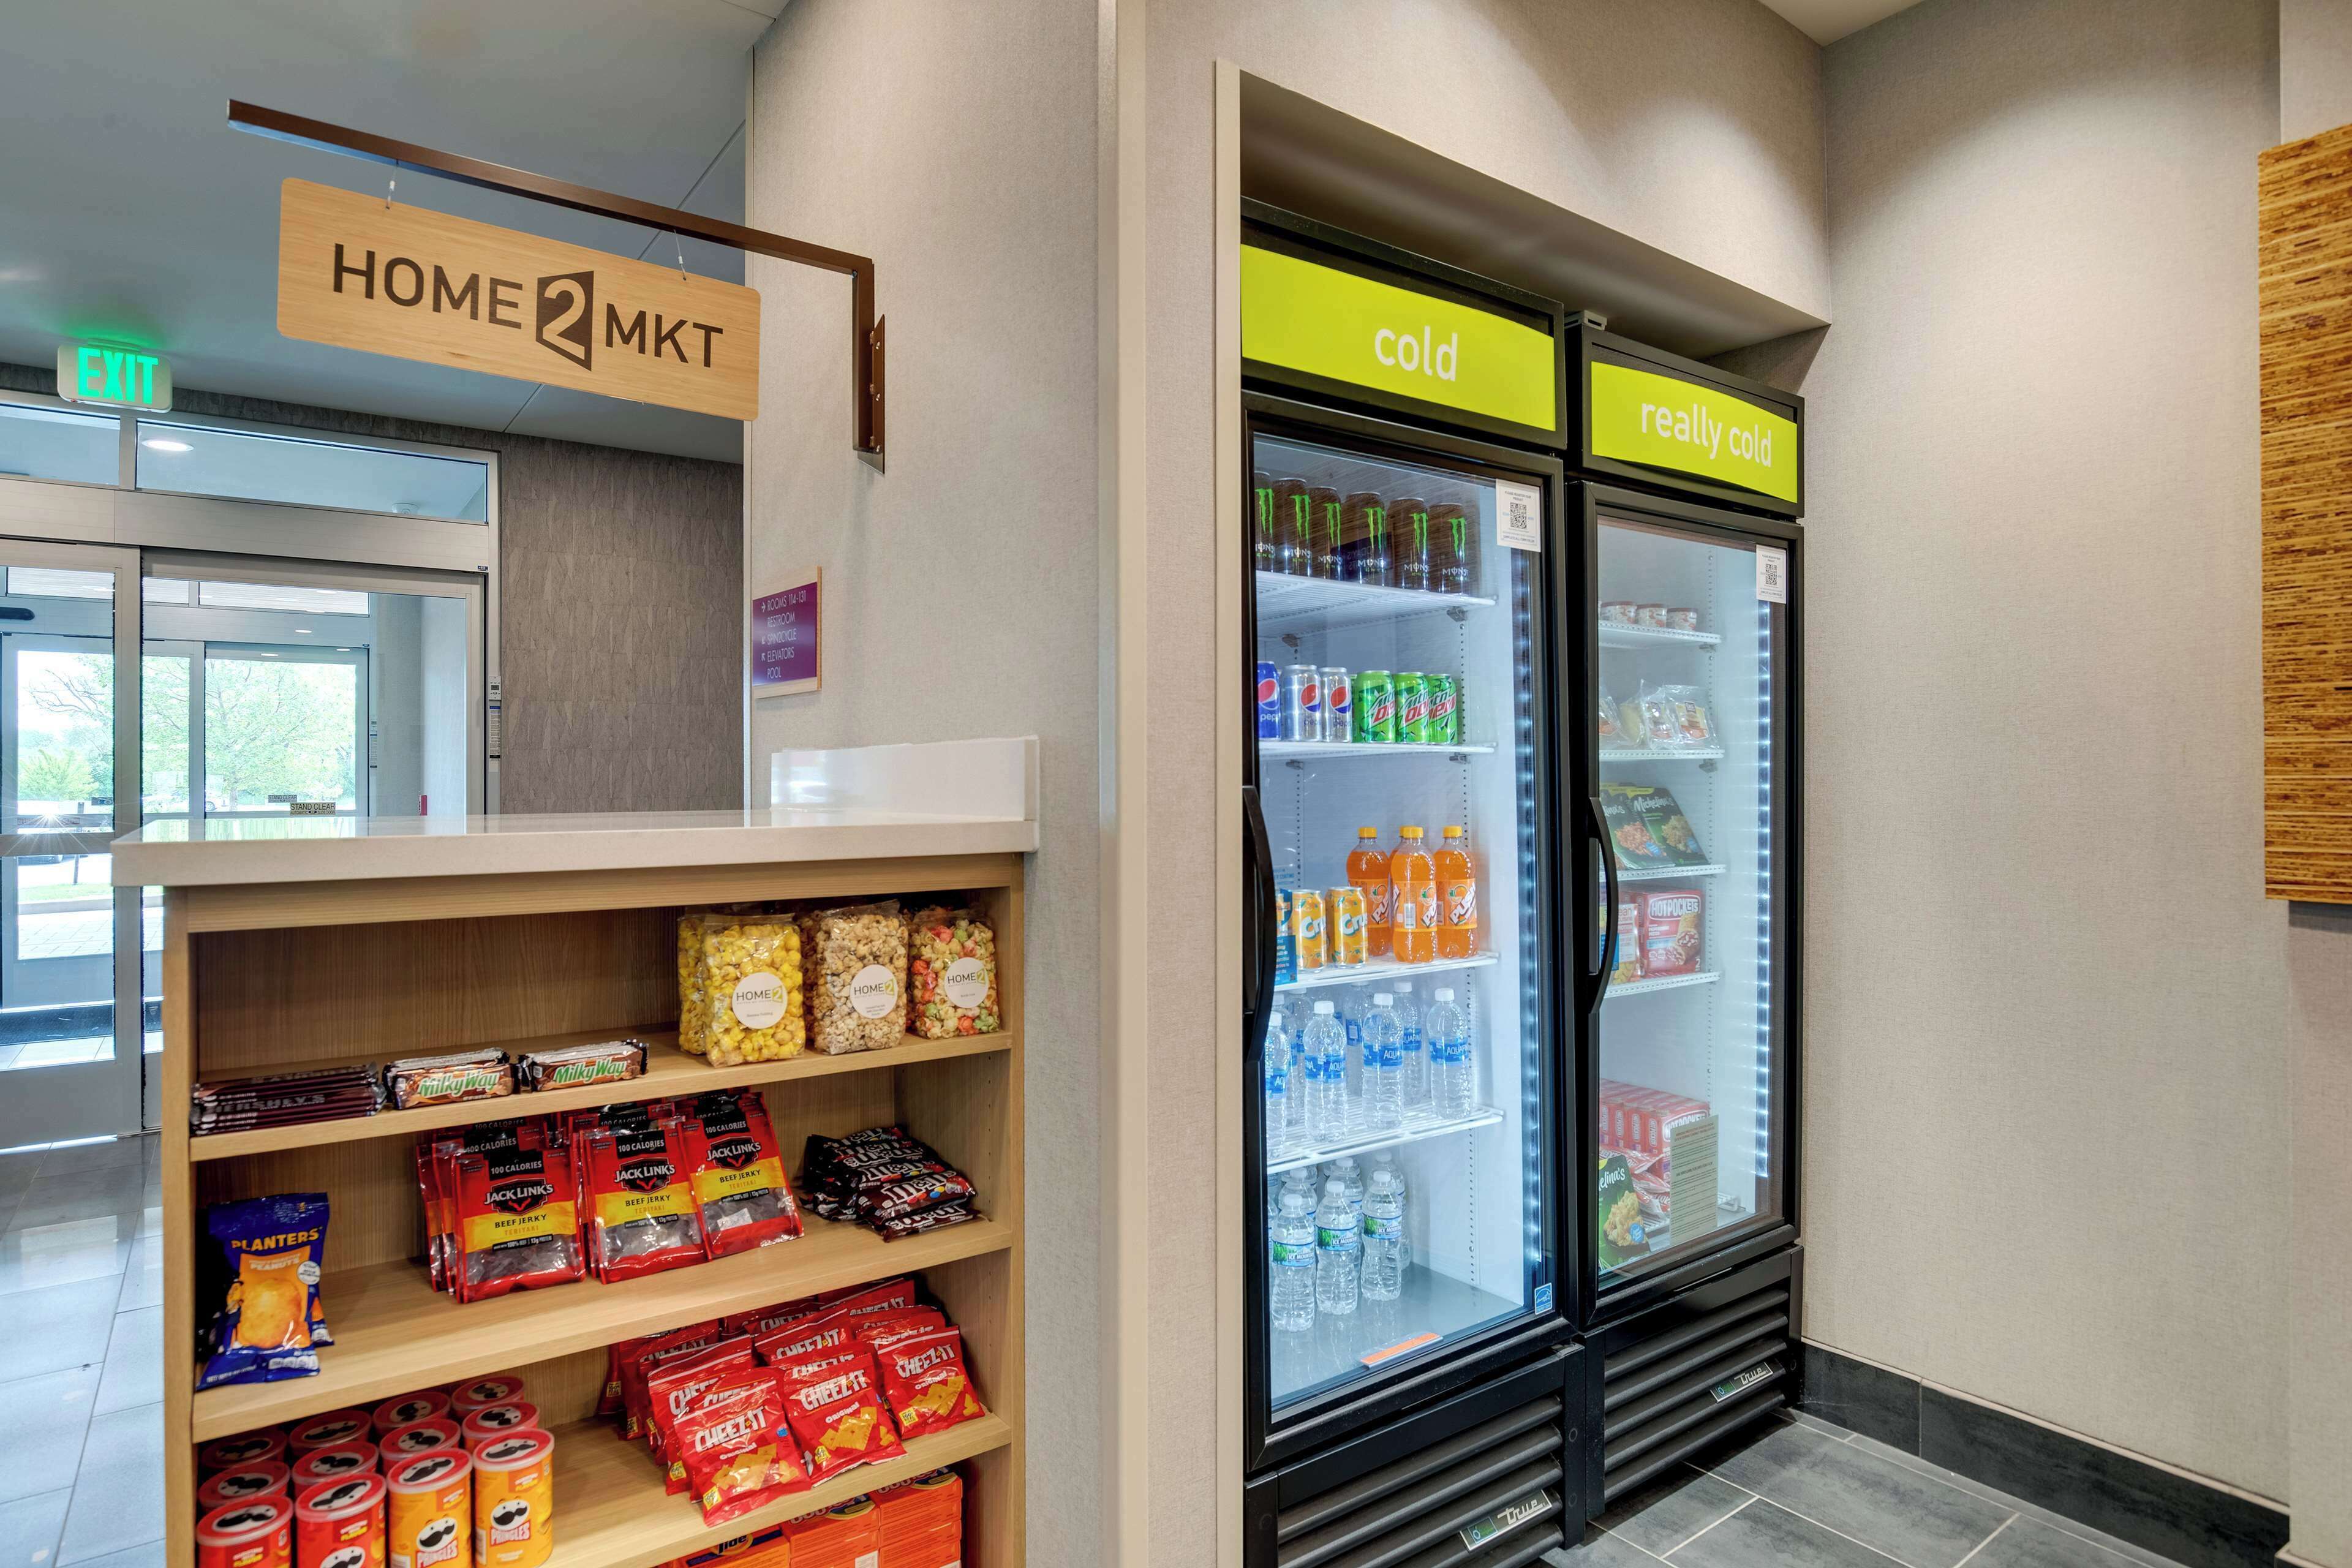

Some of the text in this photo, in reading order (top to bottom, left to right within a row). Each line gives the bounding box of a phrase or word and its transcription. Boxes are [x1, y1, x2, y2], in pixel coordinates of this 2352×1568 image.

[606, 303, 723, 368] MKT
[1374, 325, 1458, 382] cold
[78, 347, 159, 405] EXIT
[1641, 398, 1773, 467] really cold
[767, 590, 806, 612] ROOMS 114-131
[767, 612, 795, 628] RESTROOM
[767, 646, 794, 662] ELEVATORS
[767, 666, 782, 679] POOL
[705, 1120, 747, 1134] 100 CALORIES
[480, 1137, 517, 1152] CALORIES
[617, 1139, 665, 1153] 100 CALORIES
[706, 1147, 733, 1162] JACK
[490, 1167, 504, 1175] 100
[505, 1161, 542, 1172] CALORIES
[614, 1168, 643, 1183] JACK
[720, 1169, 761, 1183] BEEF JERKY
[484, 1189, 515, 1204] JACK
[625, 1194, 671, 1207] BEEF JERKY
[494, 1213, 548, 1229] BEEF JERKY
[230, 1227, 319, 1251] PLANTERS
